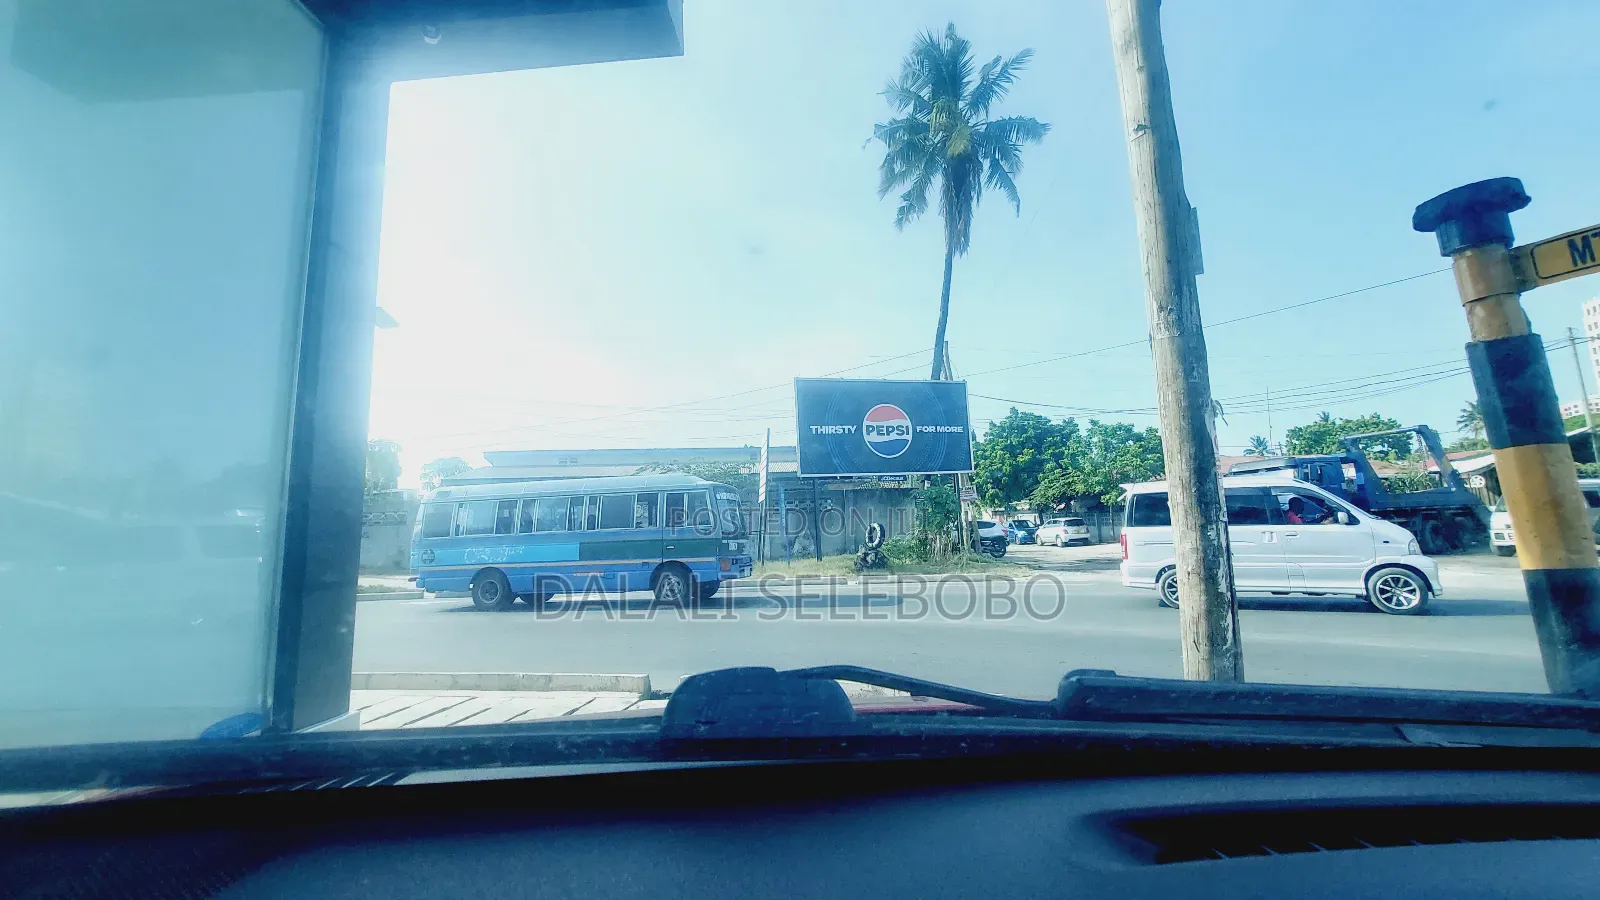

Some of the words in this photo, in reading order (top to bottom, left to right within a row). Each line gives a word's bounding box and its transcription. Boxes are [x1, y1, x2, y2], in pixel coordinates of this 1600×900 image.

[809, 425, 857, 435] THIRSTY
[865, 424, 910, 436] PEPSI
[916, 425, 937, 433] FOR
[937, 425, 964, 433] MORE
